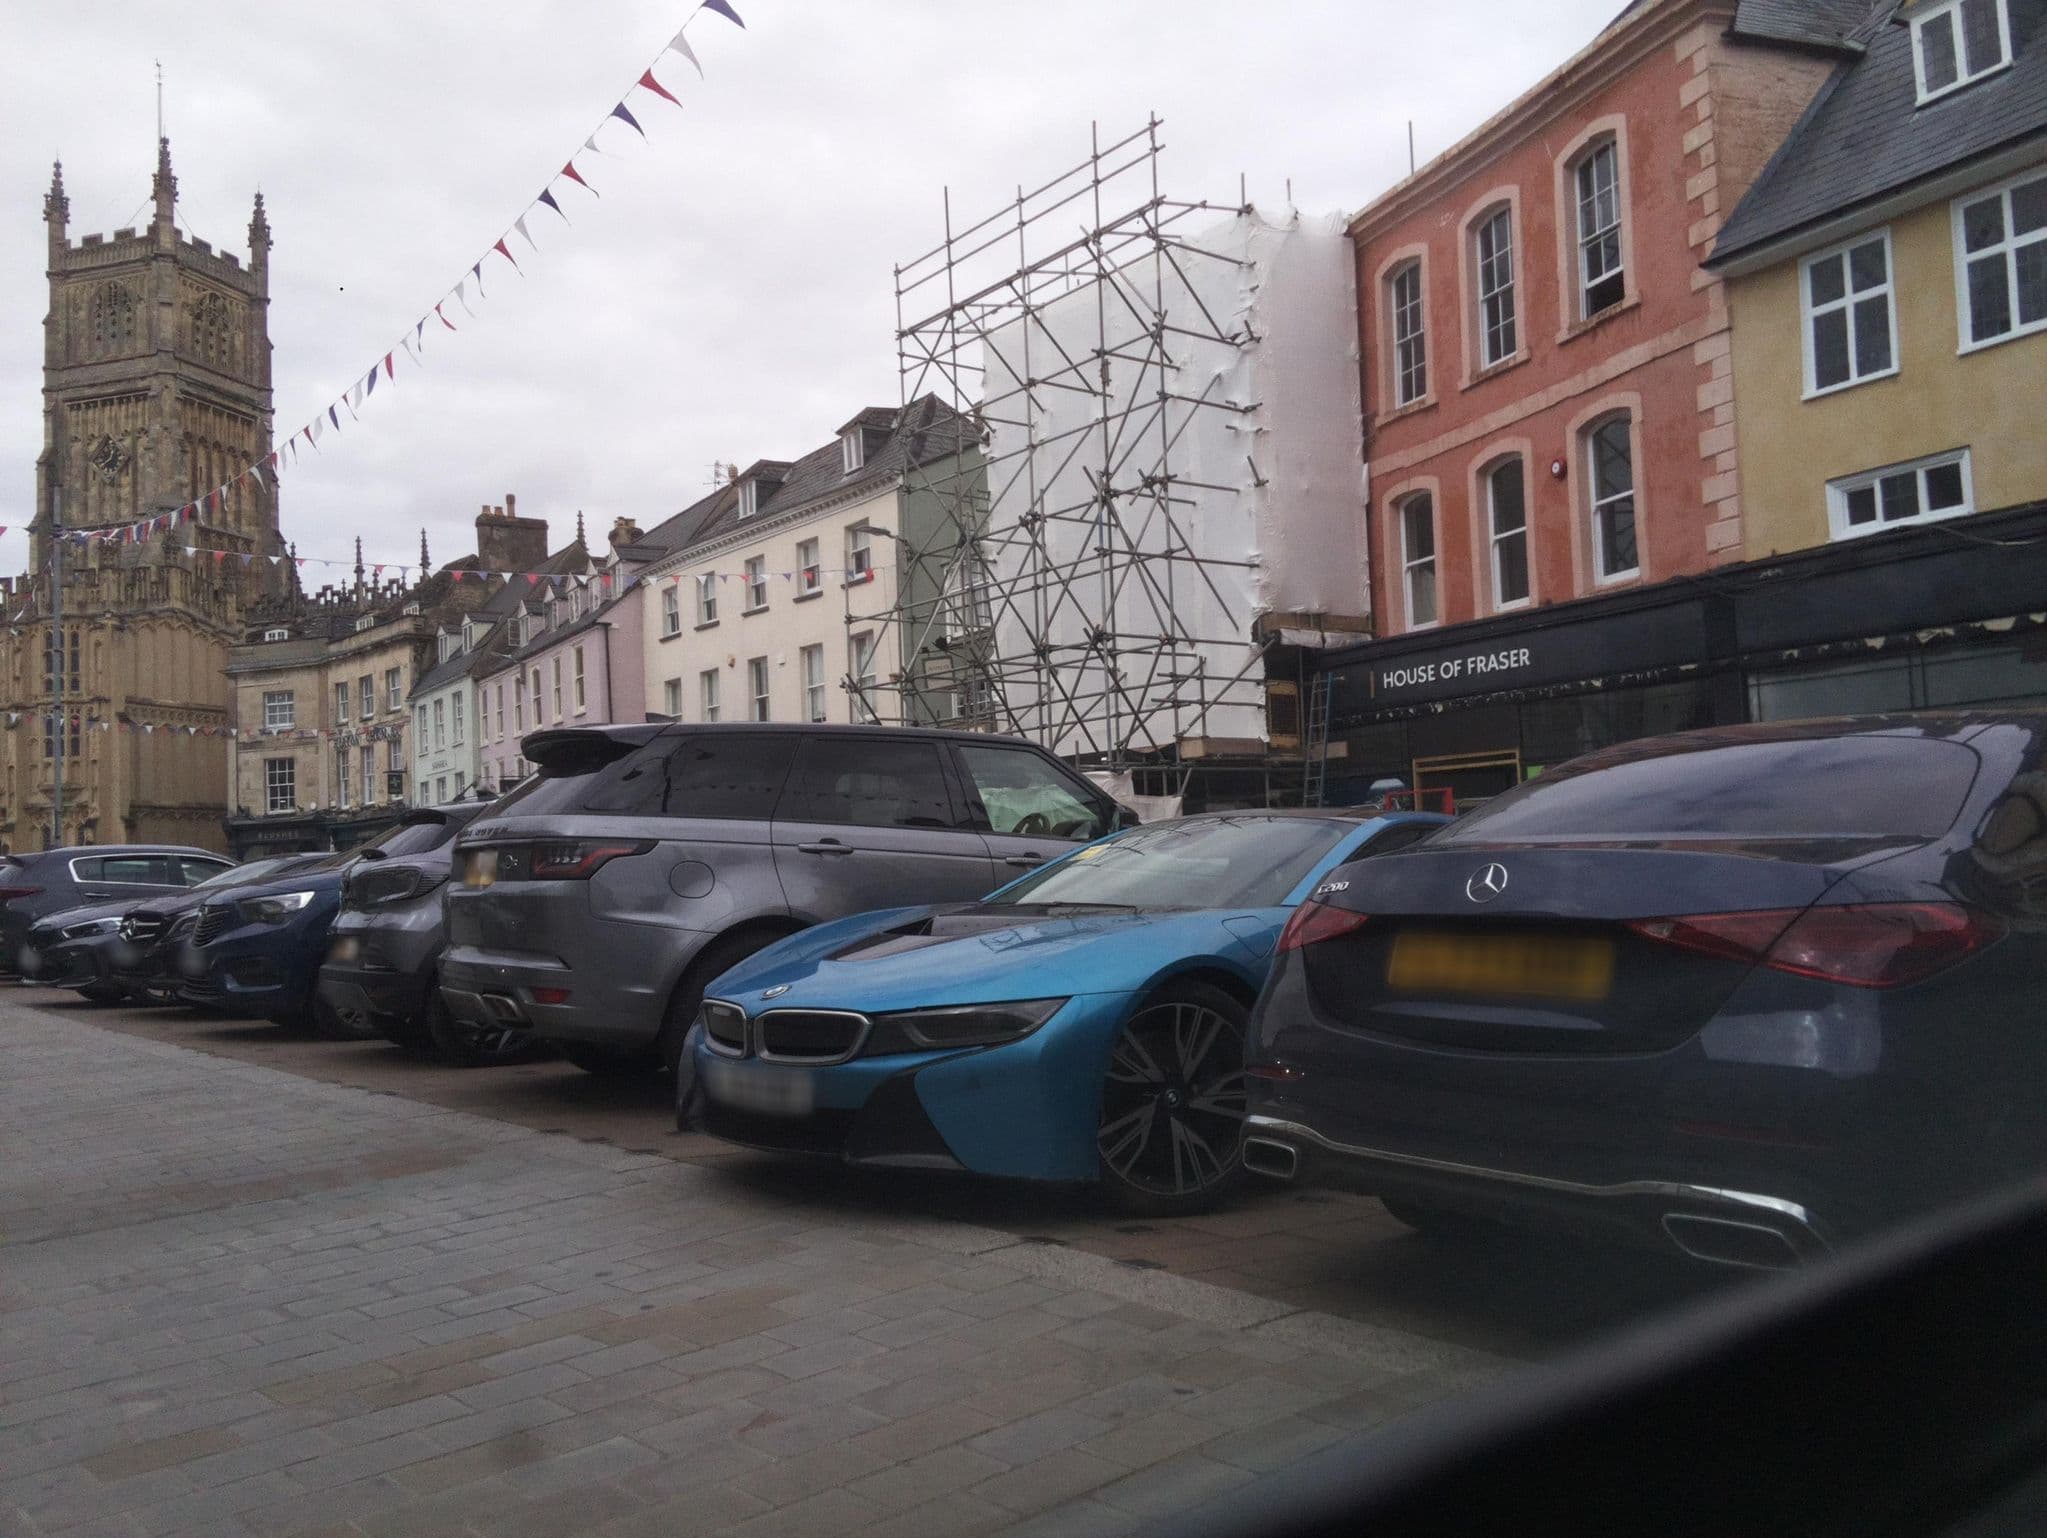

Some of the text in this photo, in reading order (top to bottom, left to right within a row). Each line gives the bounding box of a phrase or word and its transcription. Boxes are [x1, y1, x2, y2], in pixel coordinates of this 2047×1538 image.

[1383, 648, 1531, 689] HOUSE OF FRASER
